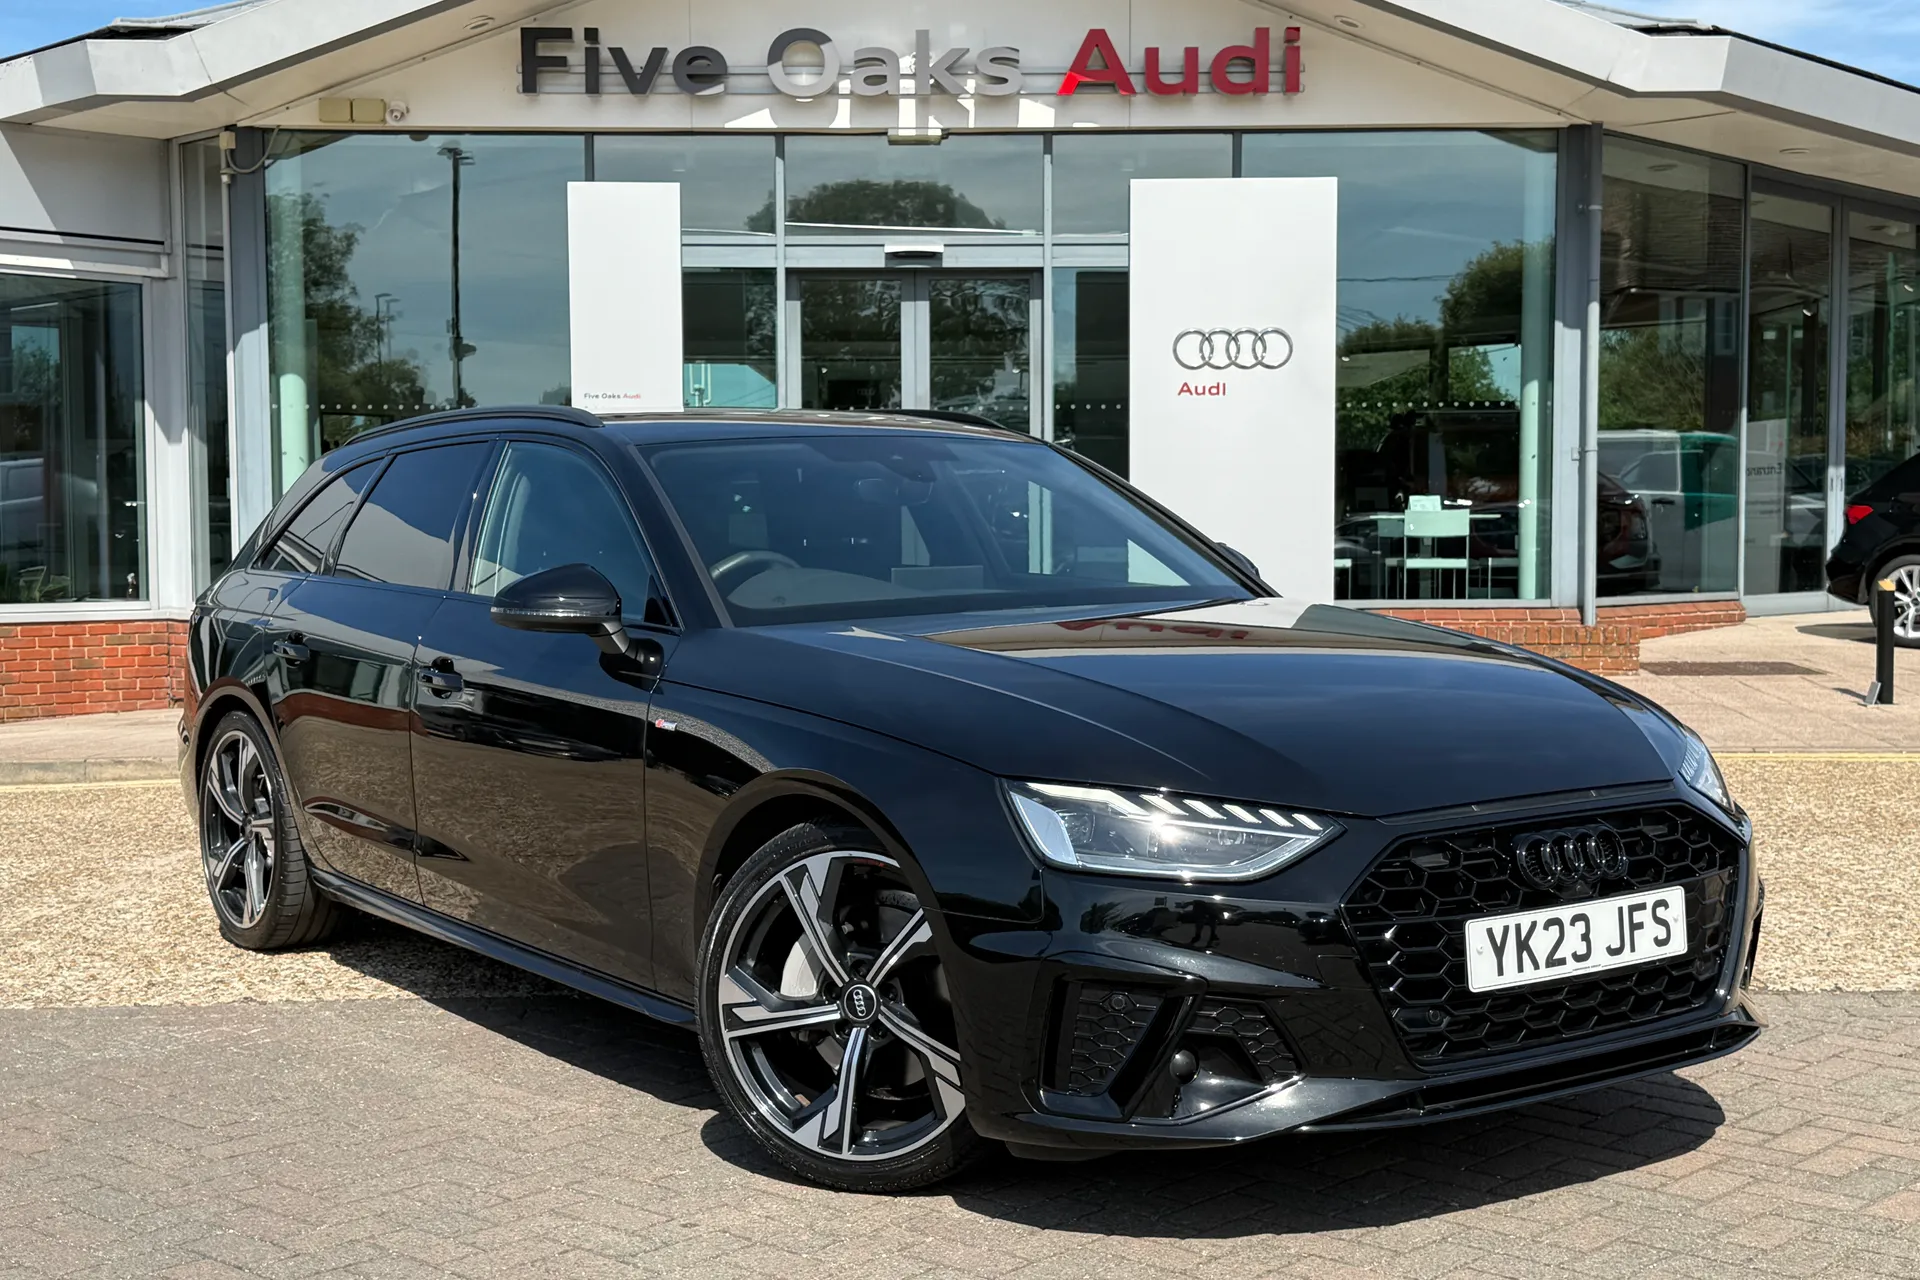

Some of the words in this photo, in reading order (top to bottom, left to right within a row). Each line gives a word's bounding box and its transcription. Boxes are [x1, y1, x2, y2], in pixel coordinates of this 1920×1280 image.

[520, 27, 728, 95] Five
[767, 27, 1024, 97] Oaks
[1056, 26, 1301, 96] Audi
[1177, 382, 1227, 396] Audi
[1485, 912, 1593, 977] YK23
[1605, 898, 1672, 957] JFS
